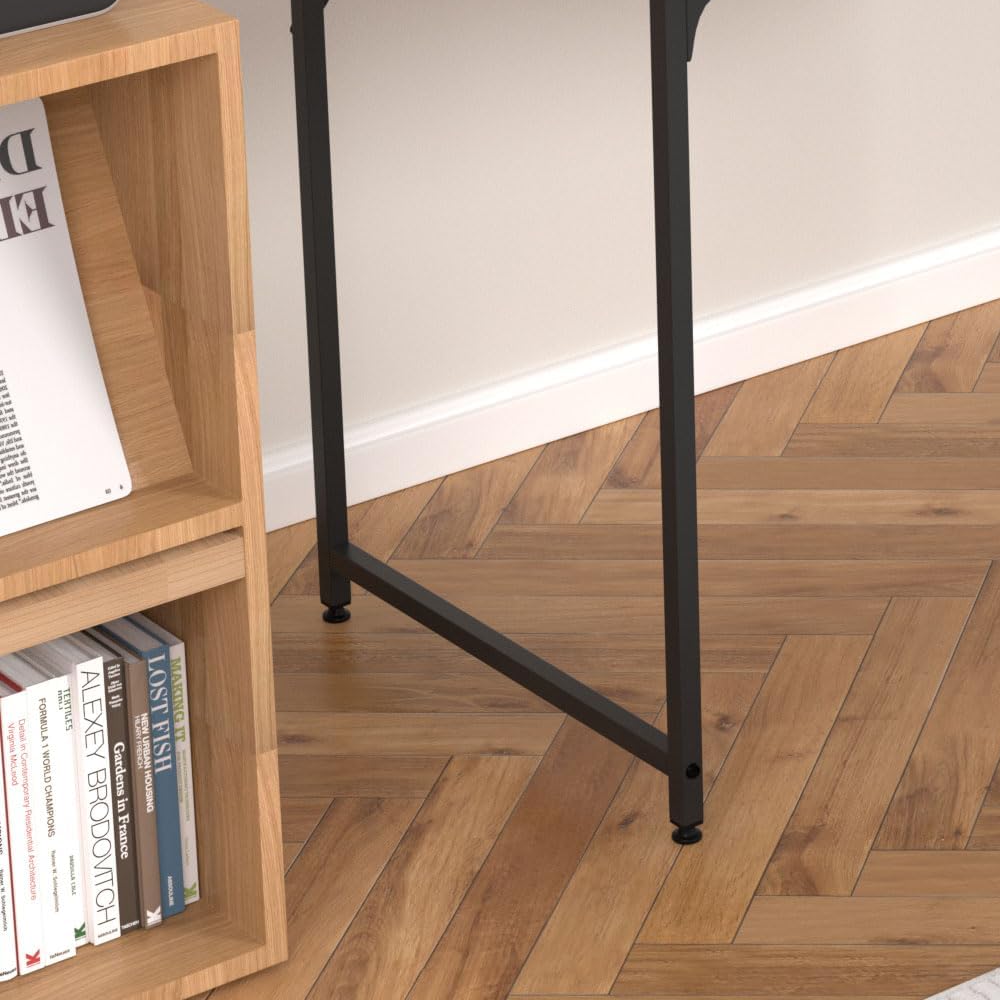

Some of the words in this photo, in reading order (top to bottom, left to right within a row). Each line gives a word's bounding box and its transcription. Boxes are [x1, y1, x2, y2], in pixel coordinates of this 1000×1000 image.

[148, 654, 169, 714] LOST
[170, 656, 185, 722] MAKING
[18, 718, 26, 742] Detail
[38, 698, 49, 742] FORMULA
[62, 688, 73, 731] TEXTILES
[80, 670, 106, 759] ALEXEY
[140, 713, 148, 734] NEW
[8, 723, 16, 753] Virginia
[142, 736, 151, 768] URBAN
[152, 720, 172, 774] FISH
[175, 725, 186, 742] IT
[20, 752, 32, 808] Contemporary
[42, 751, 52, 784] WORLD
[113, 742, 128, 798] Gardens
[45, 785, 56, 838] CHAMPIONS
[118, 798, 127, 812] in
[144, 769, 154, 813] HOUSING
[24, 809, 34, 852] Residential
[87, 768, 116, 926] BRODOVITCH
[119, 814, 130, 860] France
[28, 854, 37, 901] Architecture
